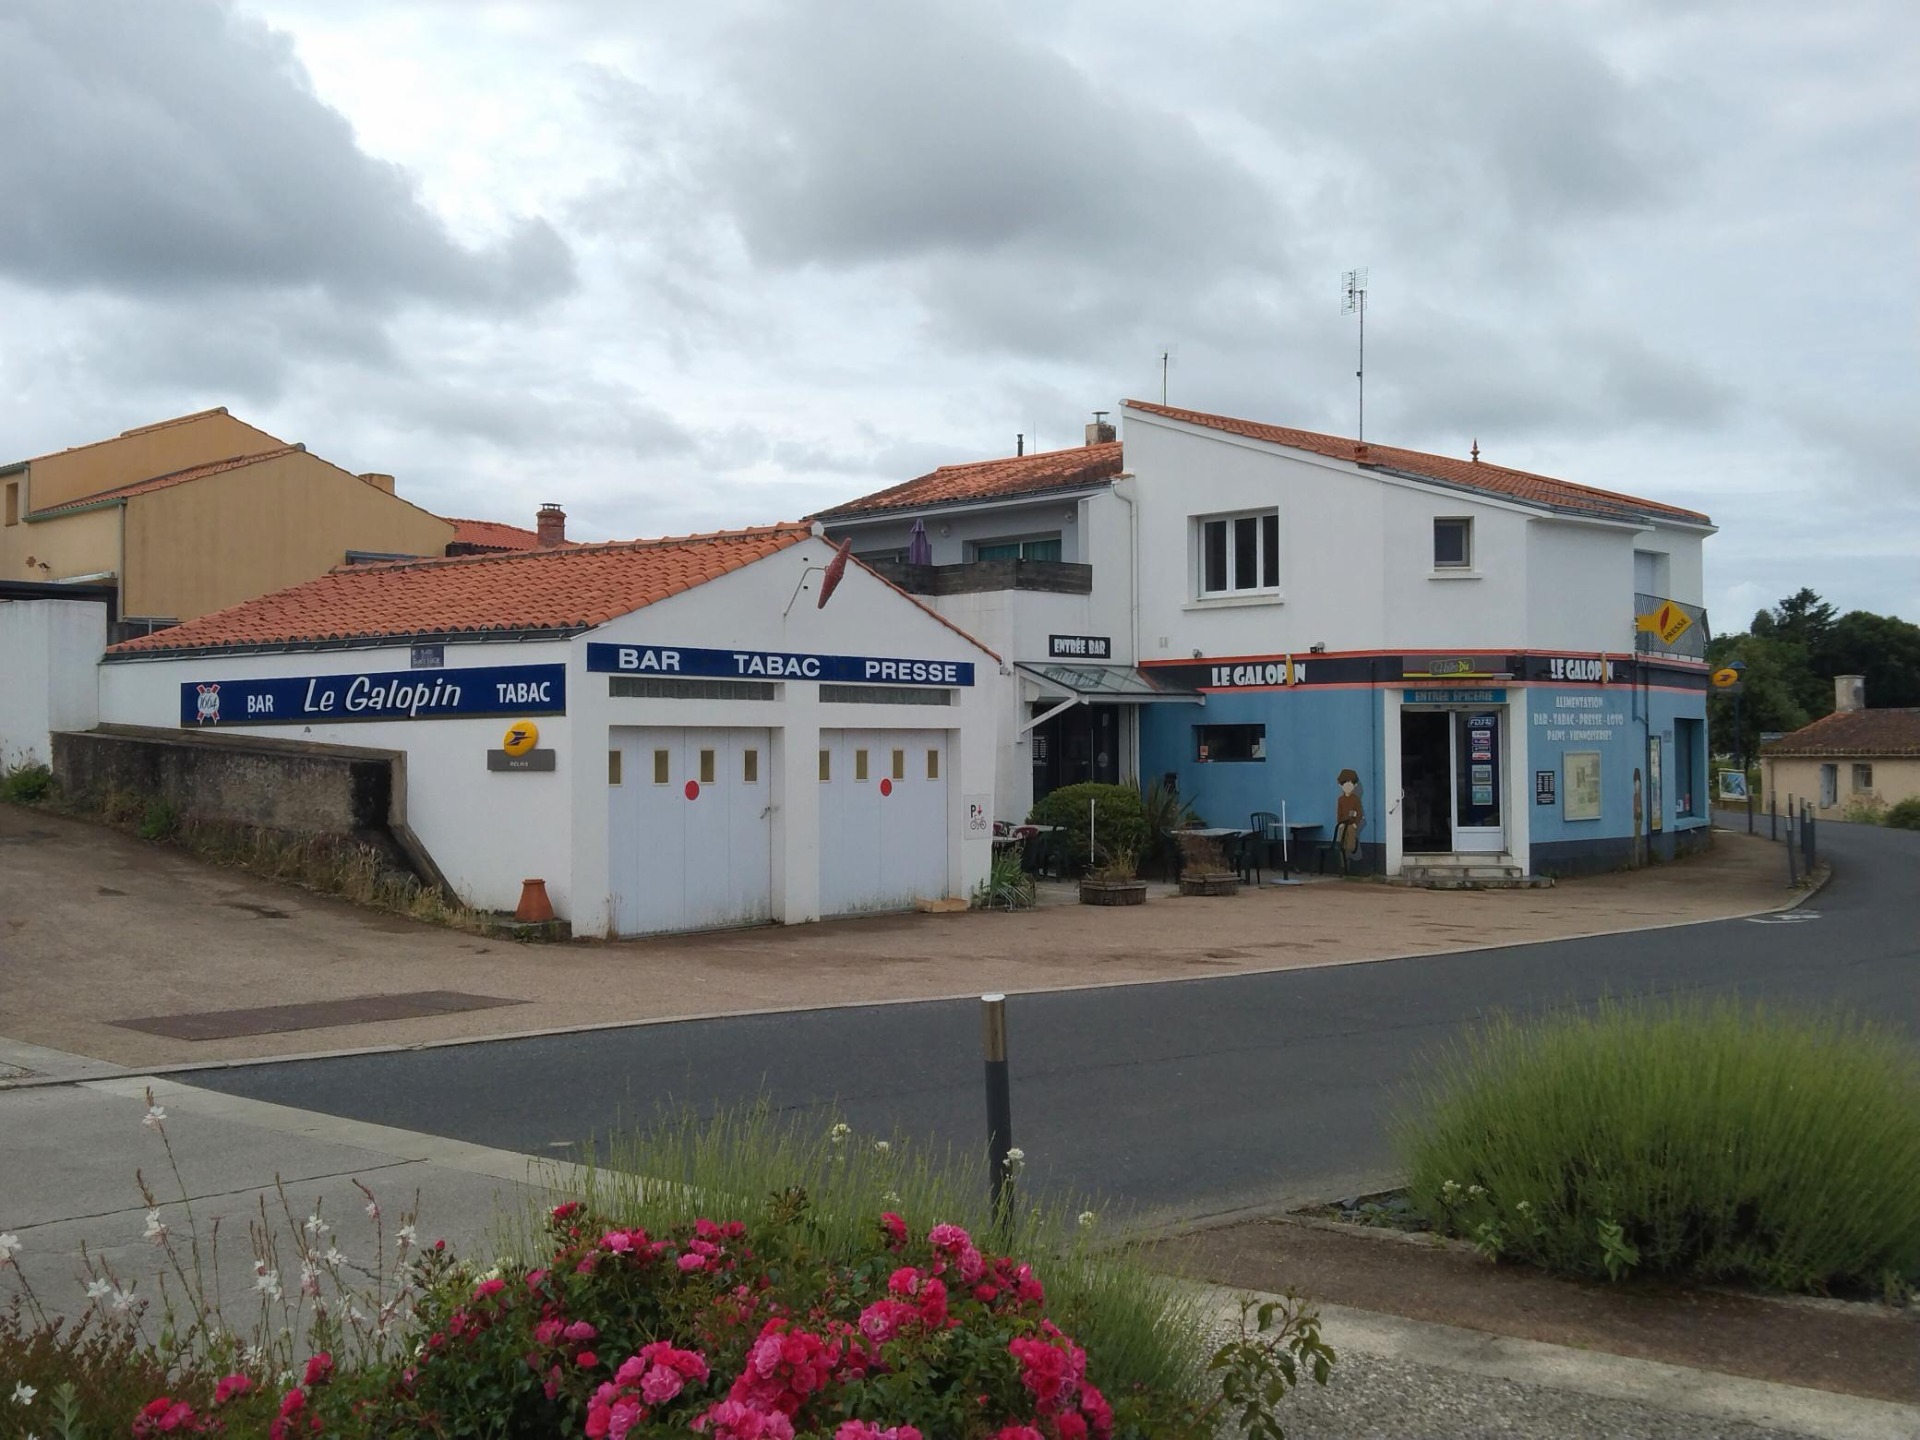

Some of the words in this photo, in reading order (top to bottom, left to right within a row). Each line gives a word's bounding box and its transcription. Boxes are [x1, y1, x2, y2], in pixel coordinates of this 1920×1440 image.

[1663, 617, 1689, 641] PRESSE
[1053, 637, 1086, 655] ENTRÉE
[1088, 639, 1106, 656] BAR
[618, 648, 681, 671] BAR
[732, 654, 821, 677] TABAC
[865, 660, 957, 682] PRESSE
[1550, 658, 1564, 679] LE
[1211, 666, 1231, 687] LE
[304, 678, 335, 712] Le
[345, 676, 462, 717] Galopin
[496, 681, 551, 704] TABAC
[1555, 696, 1603, 708] ALIMENTATION
[247, 694, 274, 713] BAR
[1470, 718, 1485, 726] FDJ
[1533, 713, 1548, 726] BAR
[1552, 713, 1575, 726] TABAC
[1579, 713, 1602, 726] PRESSE
[1606, 713, 1624, 726] LOTO
[1547, 729, 1565, 741] PAINS
[970, 804, 977, 818] P
